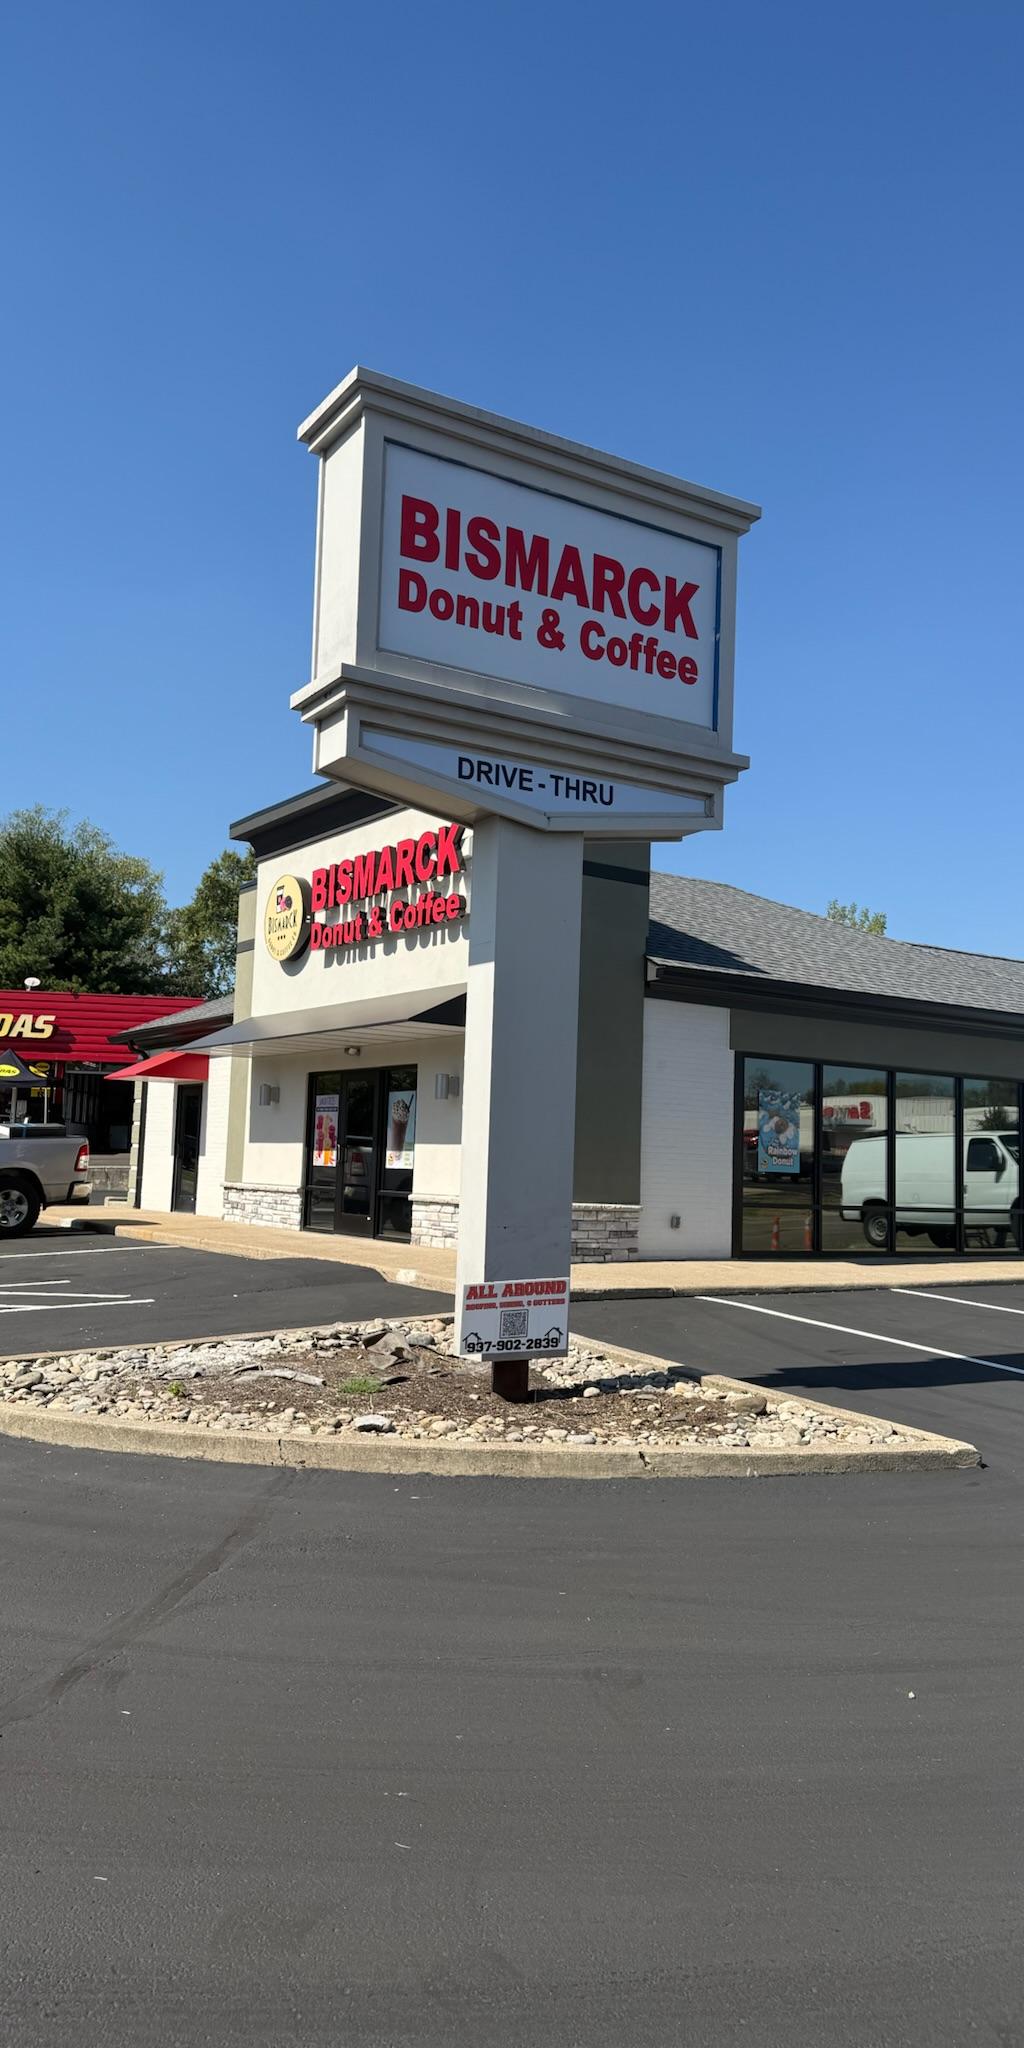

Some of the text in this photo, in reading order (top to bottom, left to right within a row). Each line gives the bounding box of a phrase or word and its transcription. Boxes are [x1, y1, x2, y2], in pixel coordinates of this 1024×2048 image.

[400, 495, 700, 640] BISMARCK
[398, 568, 698, 685] Donut & Coffee
[311, 823, 460, 912] BISMARCK
[310, 914, 362, 950] Donut
[369, 906, 382, 937] &
[390, 892, 460, 932] Coffee
[767, 1146, 798, 1157] Rainbow
[772, 1156, 794, 1166] Donut
[466, 1280, 567, 1300] ALL AROUND
[466, 1338, 559, 1353] 937-902-2839
